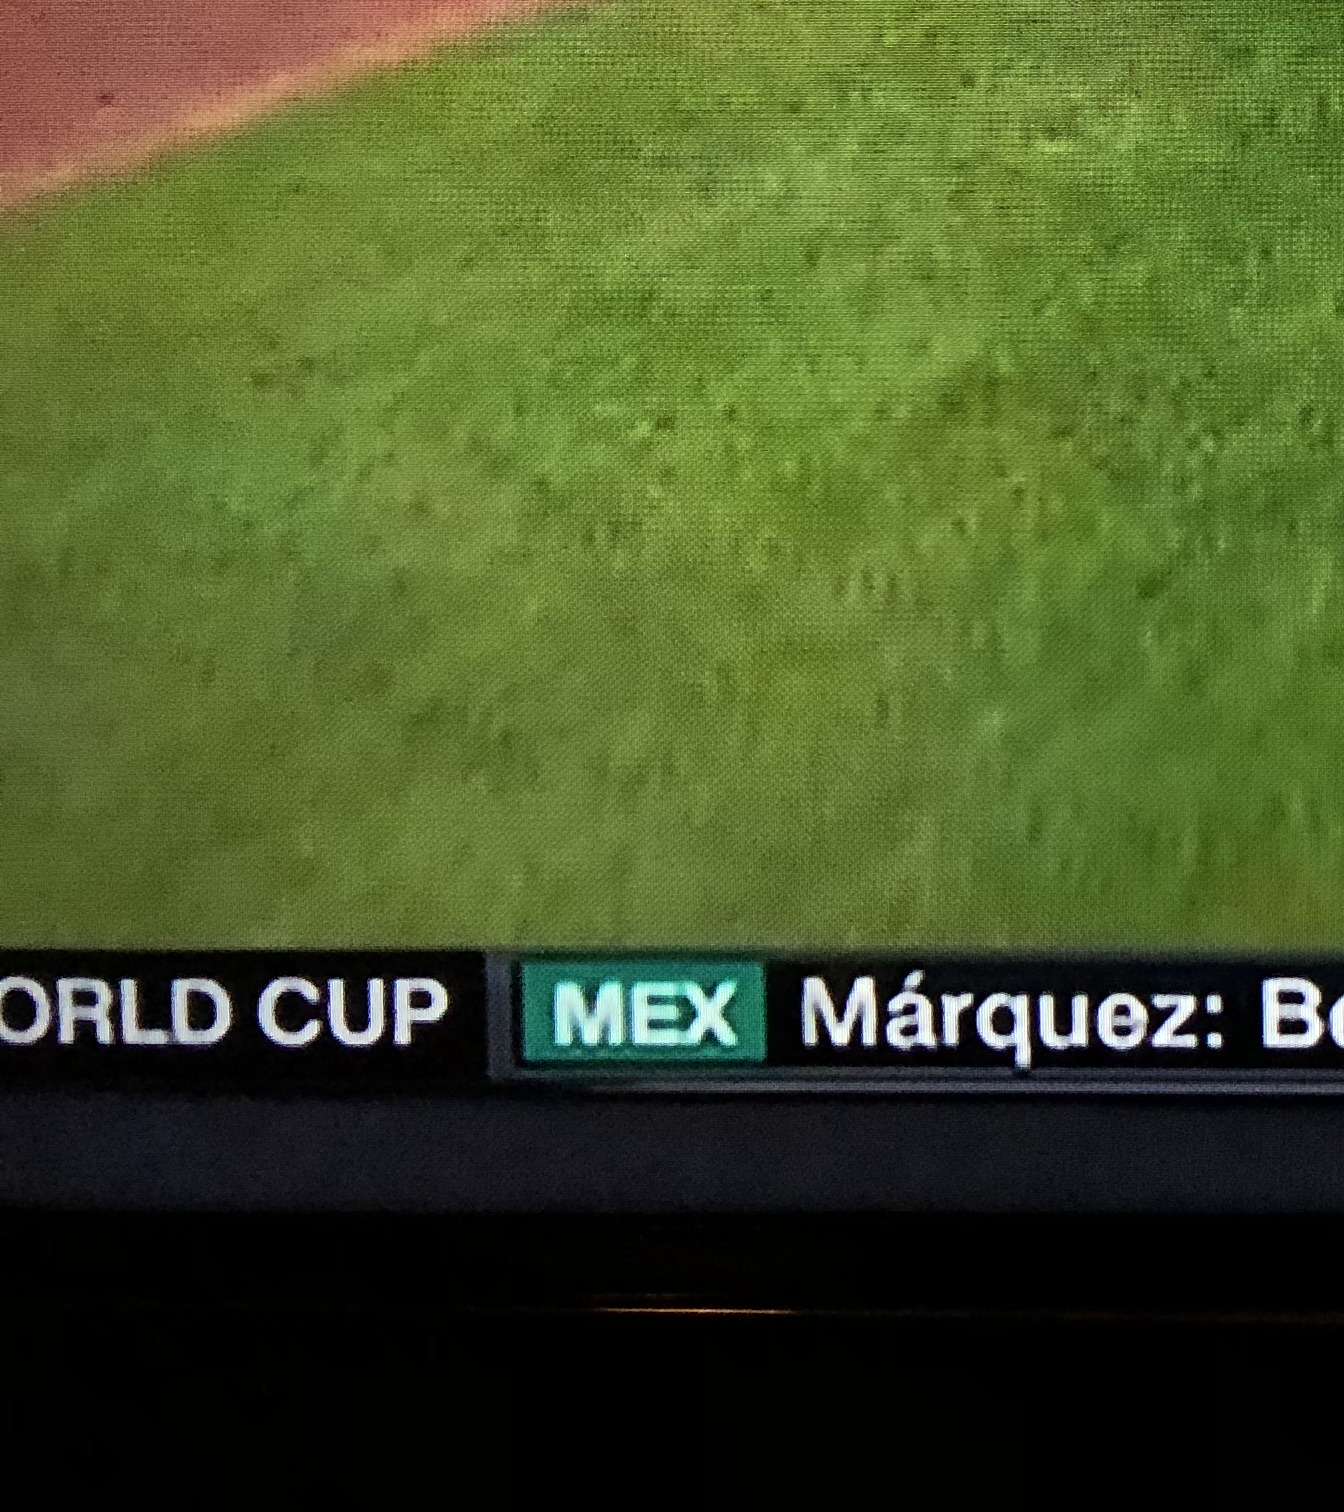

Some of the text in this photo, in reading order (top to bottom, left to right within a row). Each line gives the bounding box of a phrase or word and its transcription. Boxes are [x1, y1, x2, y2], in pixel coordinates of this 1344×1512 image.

[0, 975, 452, 1048] ORLD CUP
[552, 979, 739, 1049] MEX
[801, 970, 1225, 1072] Márquez:
